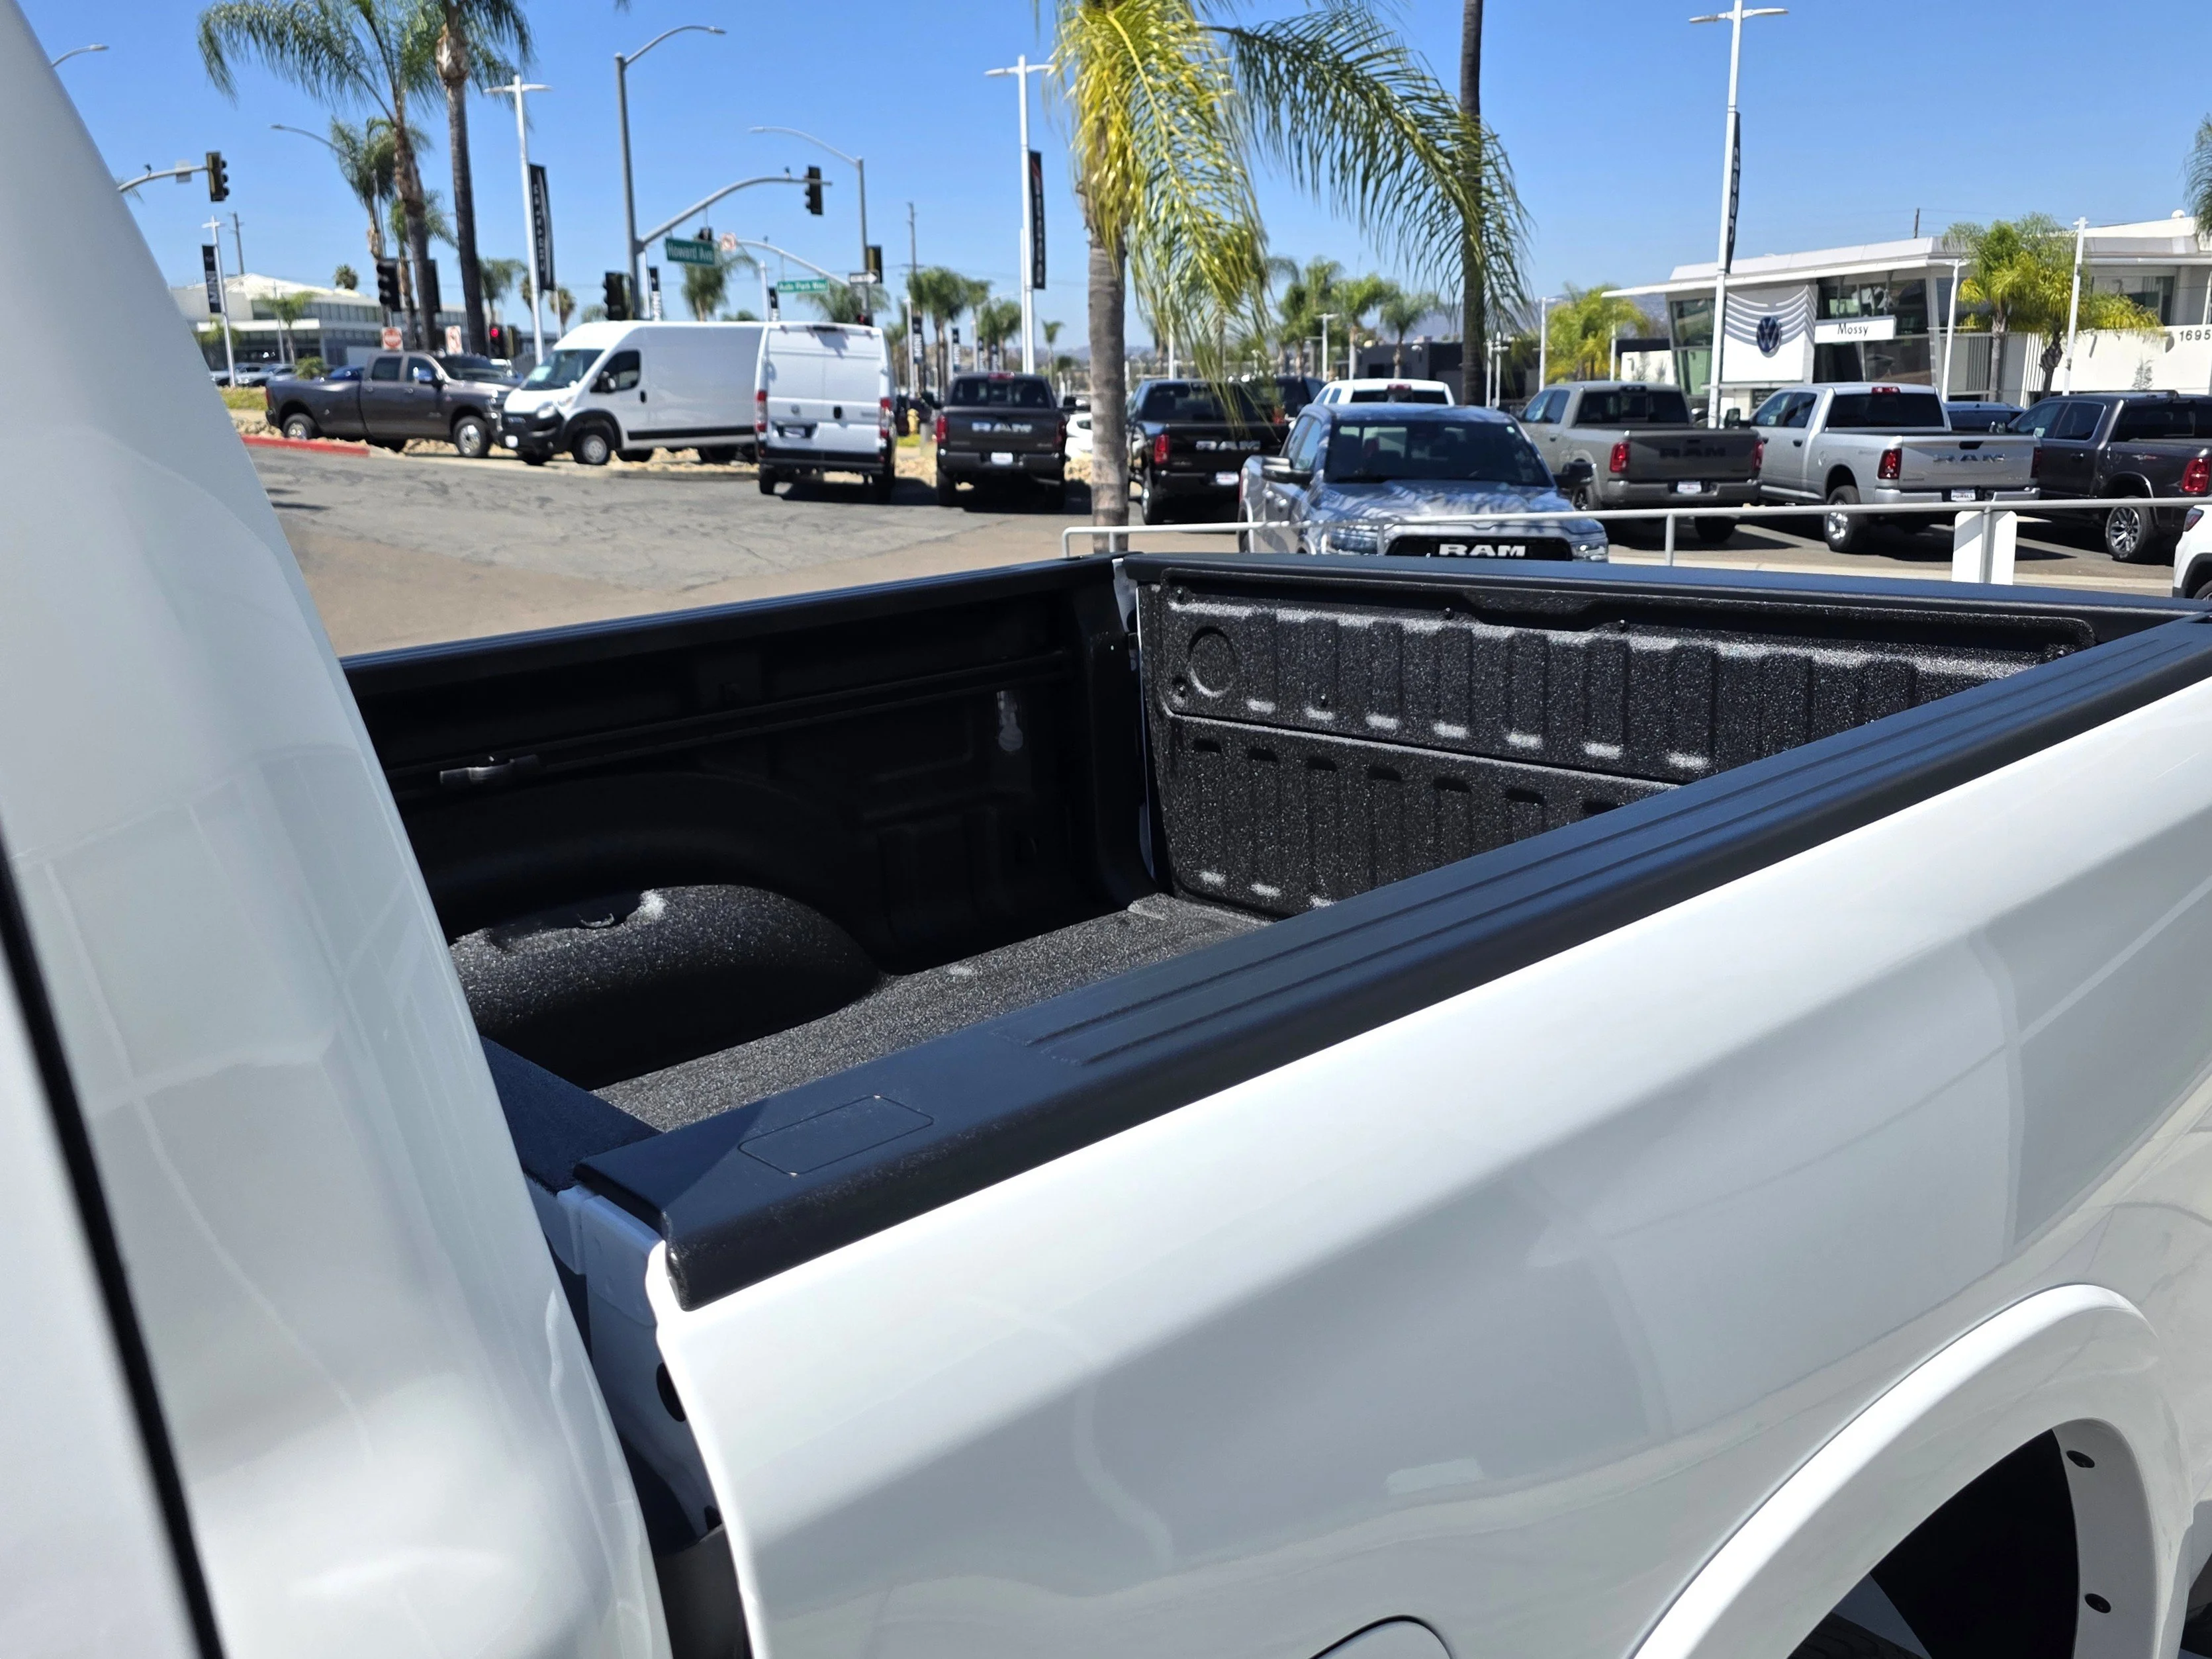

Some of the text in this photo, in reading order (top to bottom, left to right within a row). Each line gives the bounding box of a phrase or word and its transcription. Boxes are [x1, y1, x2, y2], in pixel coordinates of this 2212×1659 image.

[667, 242, 714, 261] Howard Ave
[1837, 324, 1868, 336] Mossy
[2180, 329, 2211, 341] 1695
[972, 422, 1033, 432] RAM
[1195, 440, 1260, 451] RAM
[1933, 453, 2005, 464] RAM
[1439, 544, 1526, 556] RAM
